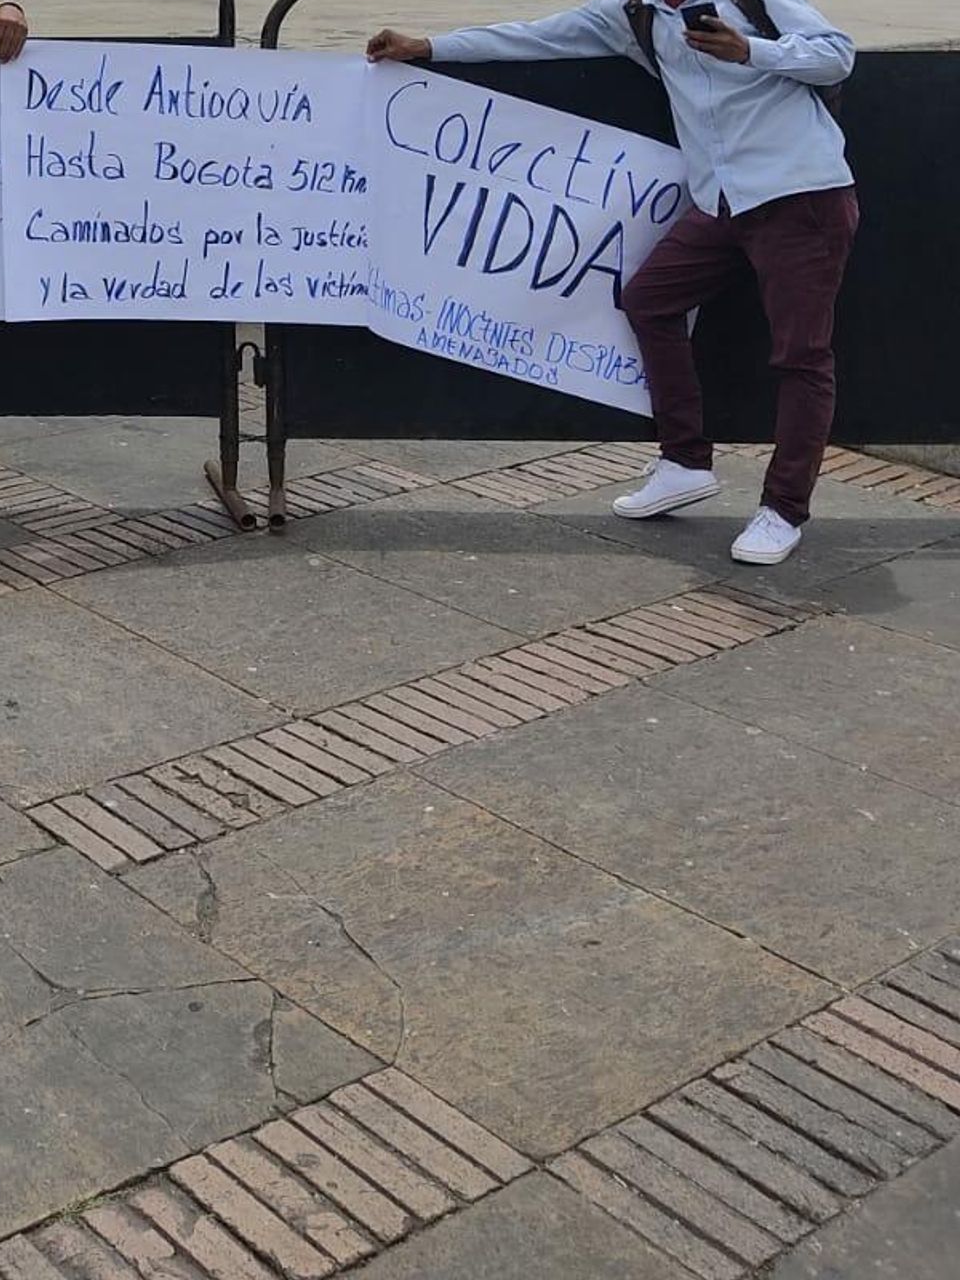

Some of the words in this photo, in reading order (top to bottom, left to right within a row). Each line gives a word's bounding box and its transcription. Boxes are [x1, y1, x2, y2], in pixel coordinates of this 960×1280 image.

[25, 53, 124, 116] Desde
[26, 130, 125, 180] Hasta
[286, 159, 336, 194] 512
[203, 227, 243, 260] por
[257, 211, 283, 247] la
[423, 173, 625, 310] VIDDA
[61, 271, 94, 304] la
[209, 260, 245, 300] de
[254, 258, 294, 298] las
